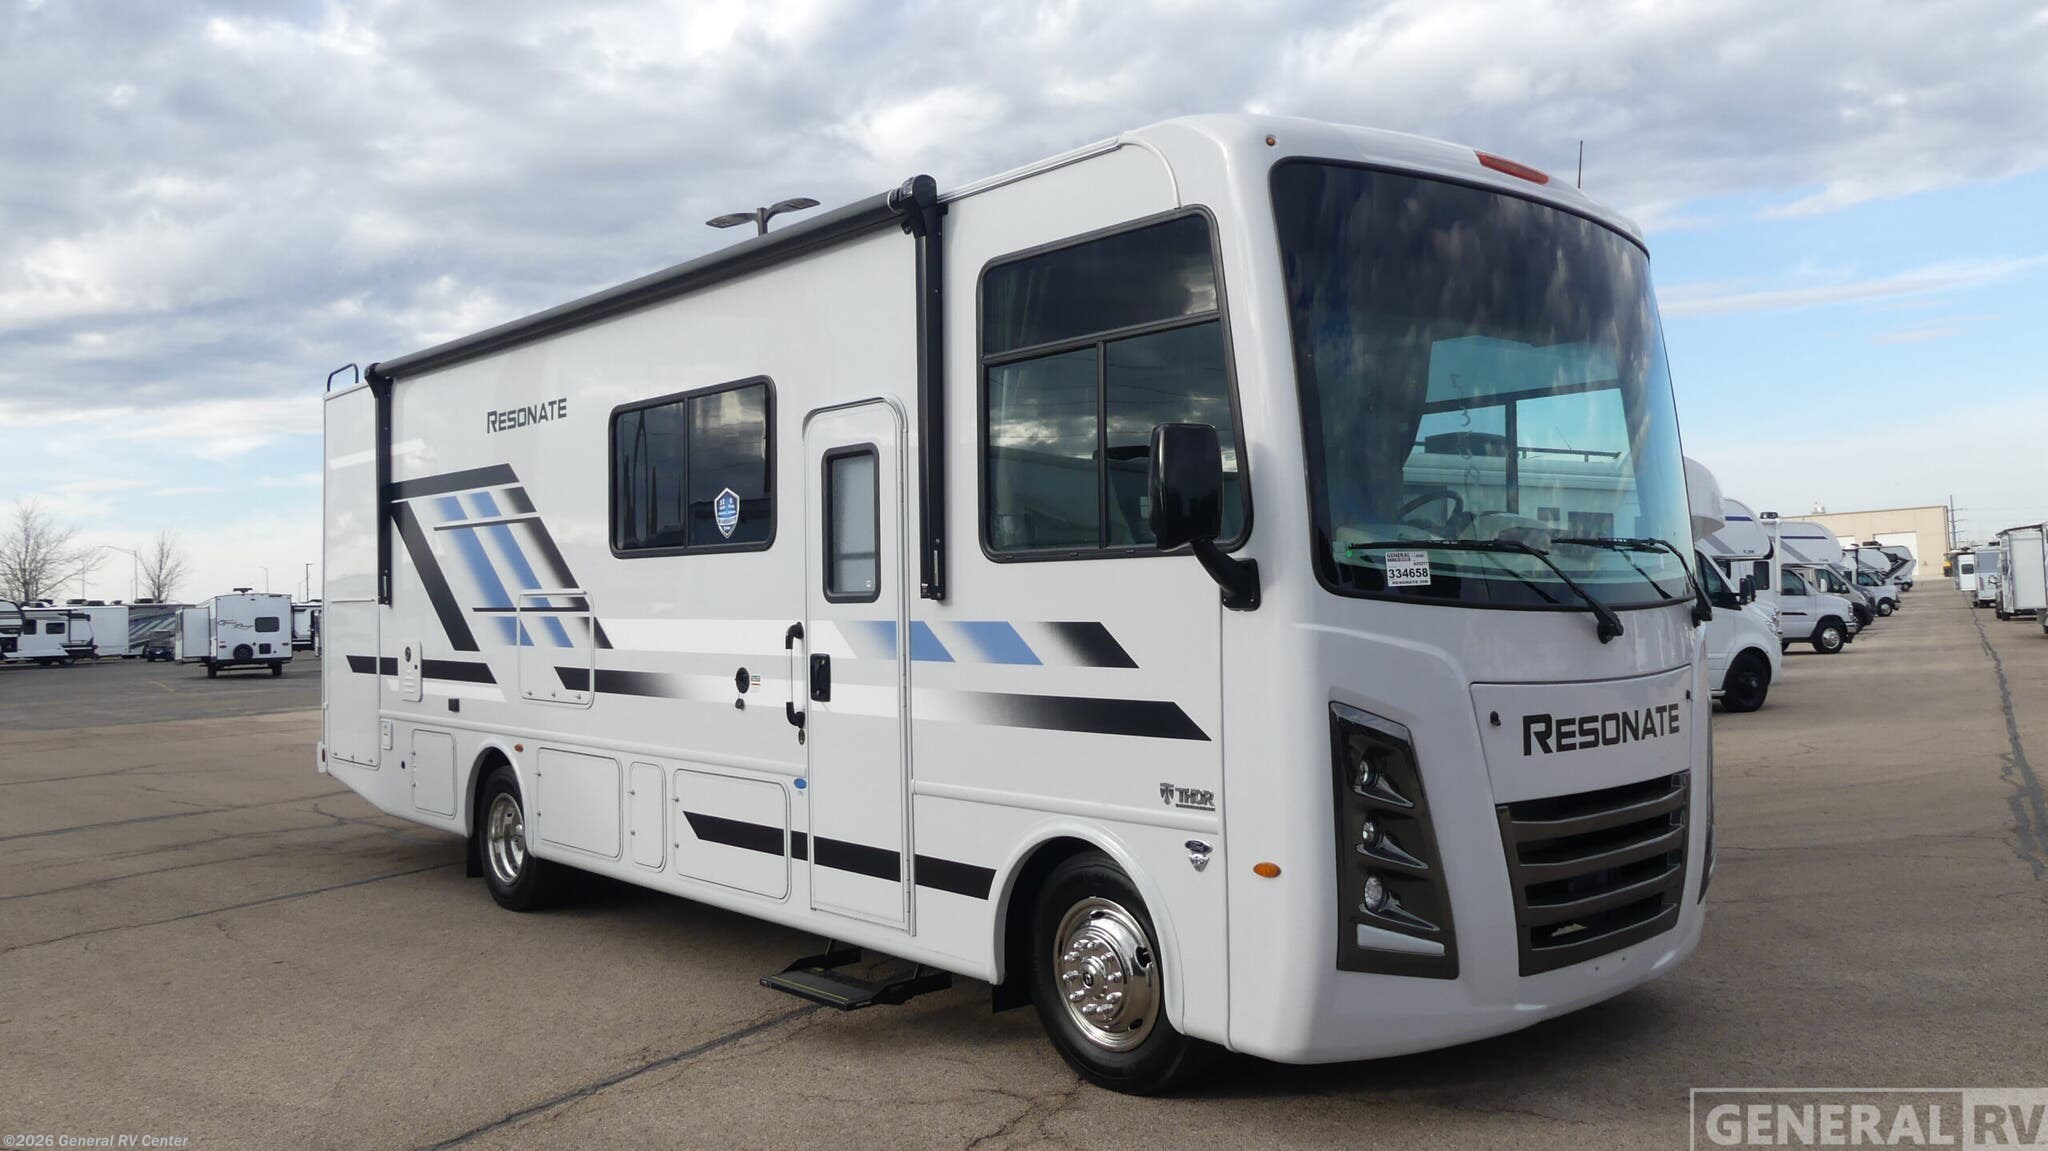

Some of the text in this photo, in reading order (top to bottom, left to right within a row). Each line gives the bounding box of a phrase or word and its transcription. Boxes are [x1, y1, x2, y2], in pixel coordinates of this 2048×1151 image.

[487, 397, 567, 434] RESONATE
[1388, 568, 1428, 578] 334658
[1522, 703, 1680, 756] RESONATE
[1174, 787, 1216, 807] THOR
